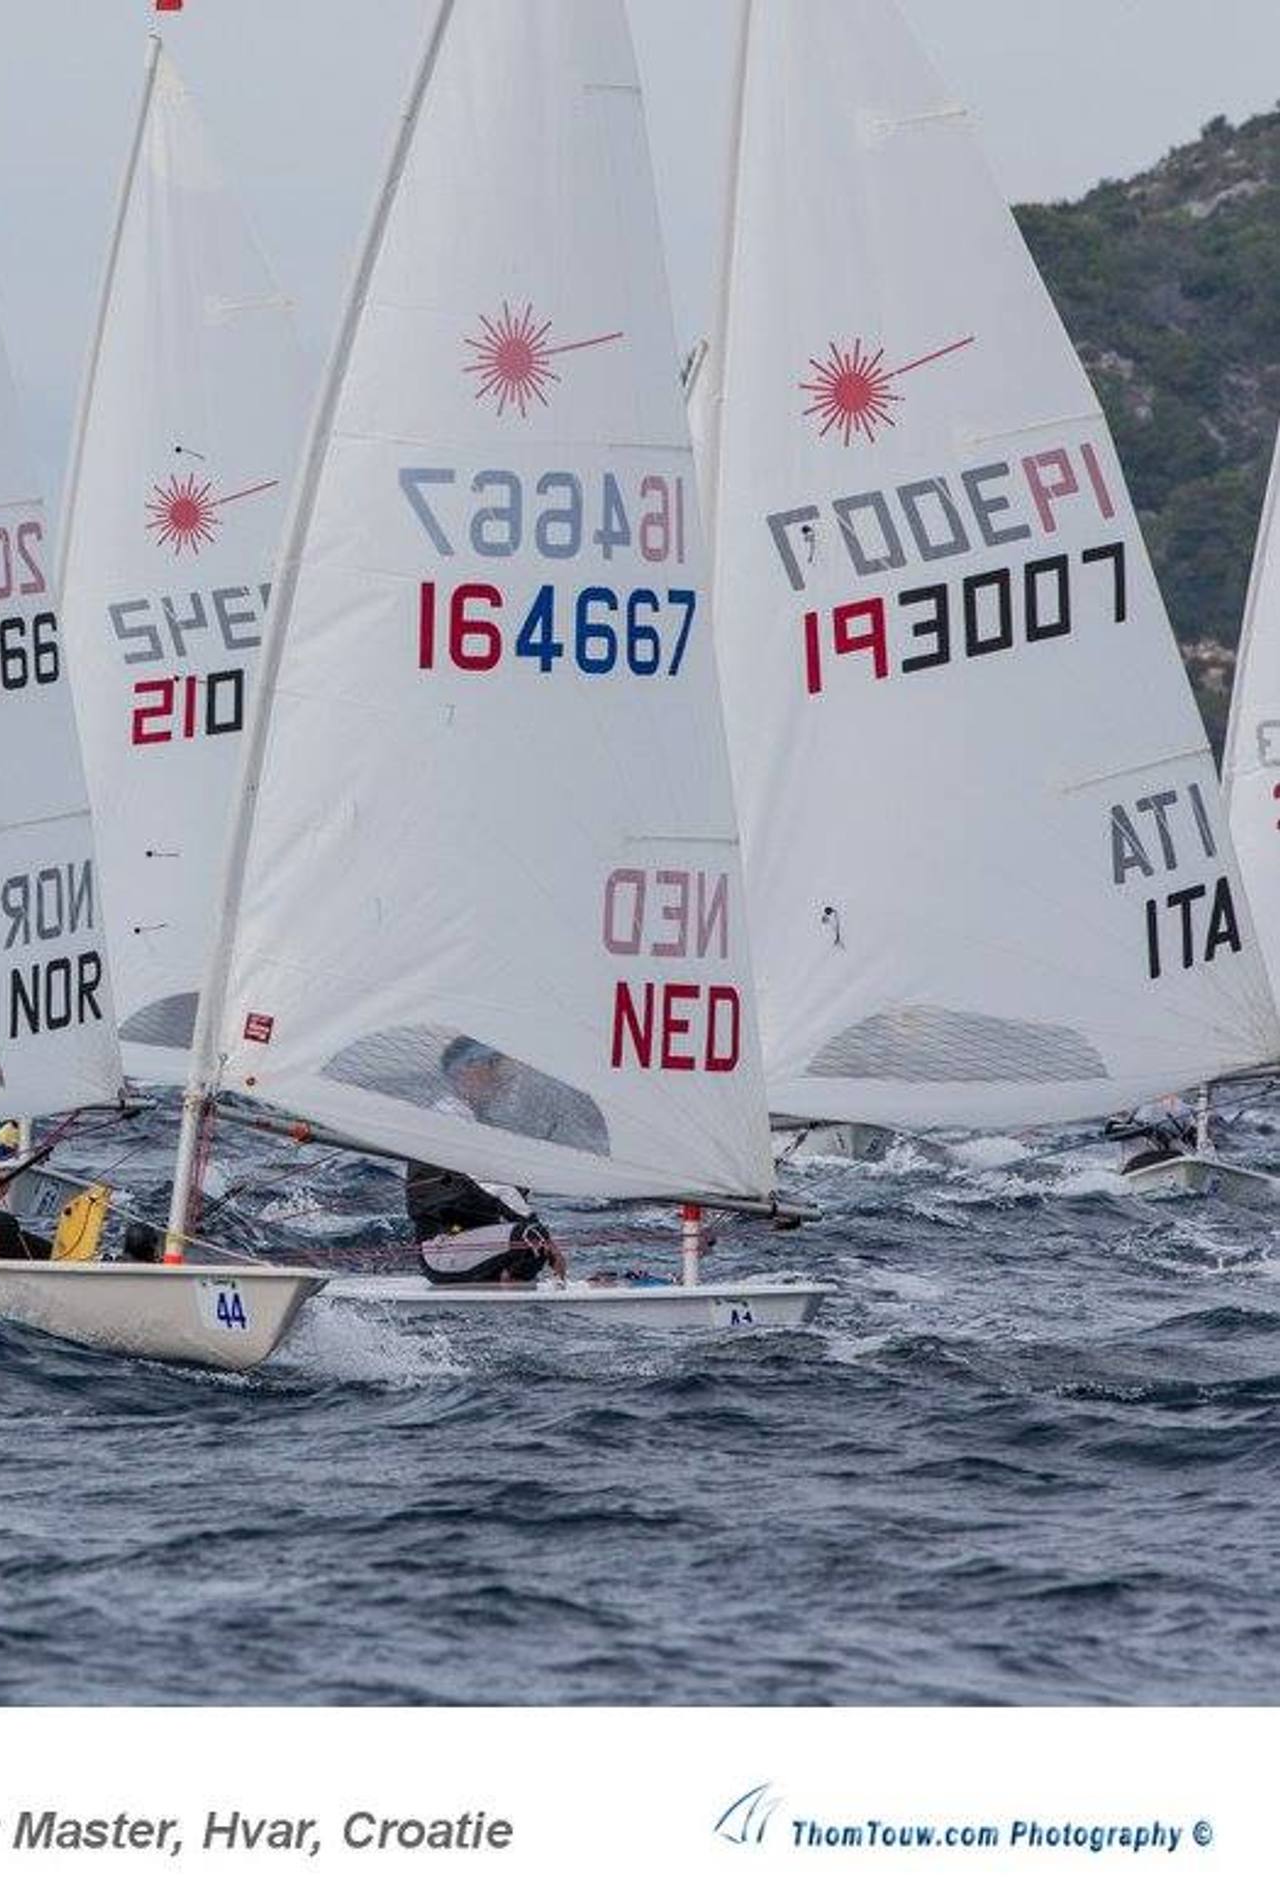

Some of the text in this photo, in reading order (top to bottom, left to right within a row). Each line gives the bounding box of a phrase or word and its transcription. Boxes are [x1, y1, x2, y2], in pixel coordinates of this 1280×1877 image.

[418, 581, 696, 677] 164667
[804, 541, 1126, 694] 193007
[1146, 877, 1242, 979] ITA
[9, 951, 103, 1038] NOR
[612, 981, 741, 1072] NED
[217, 1292, 247, 1330] 44
